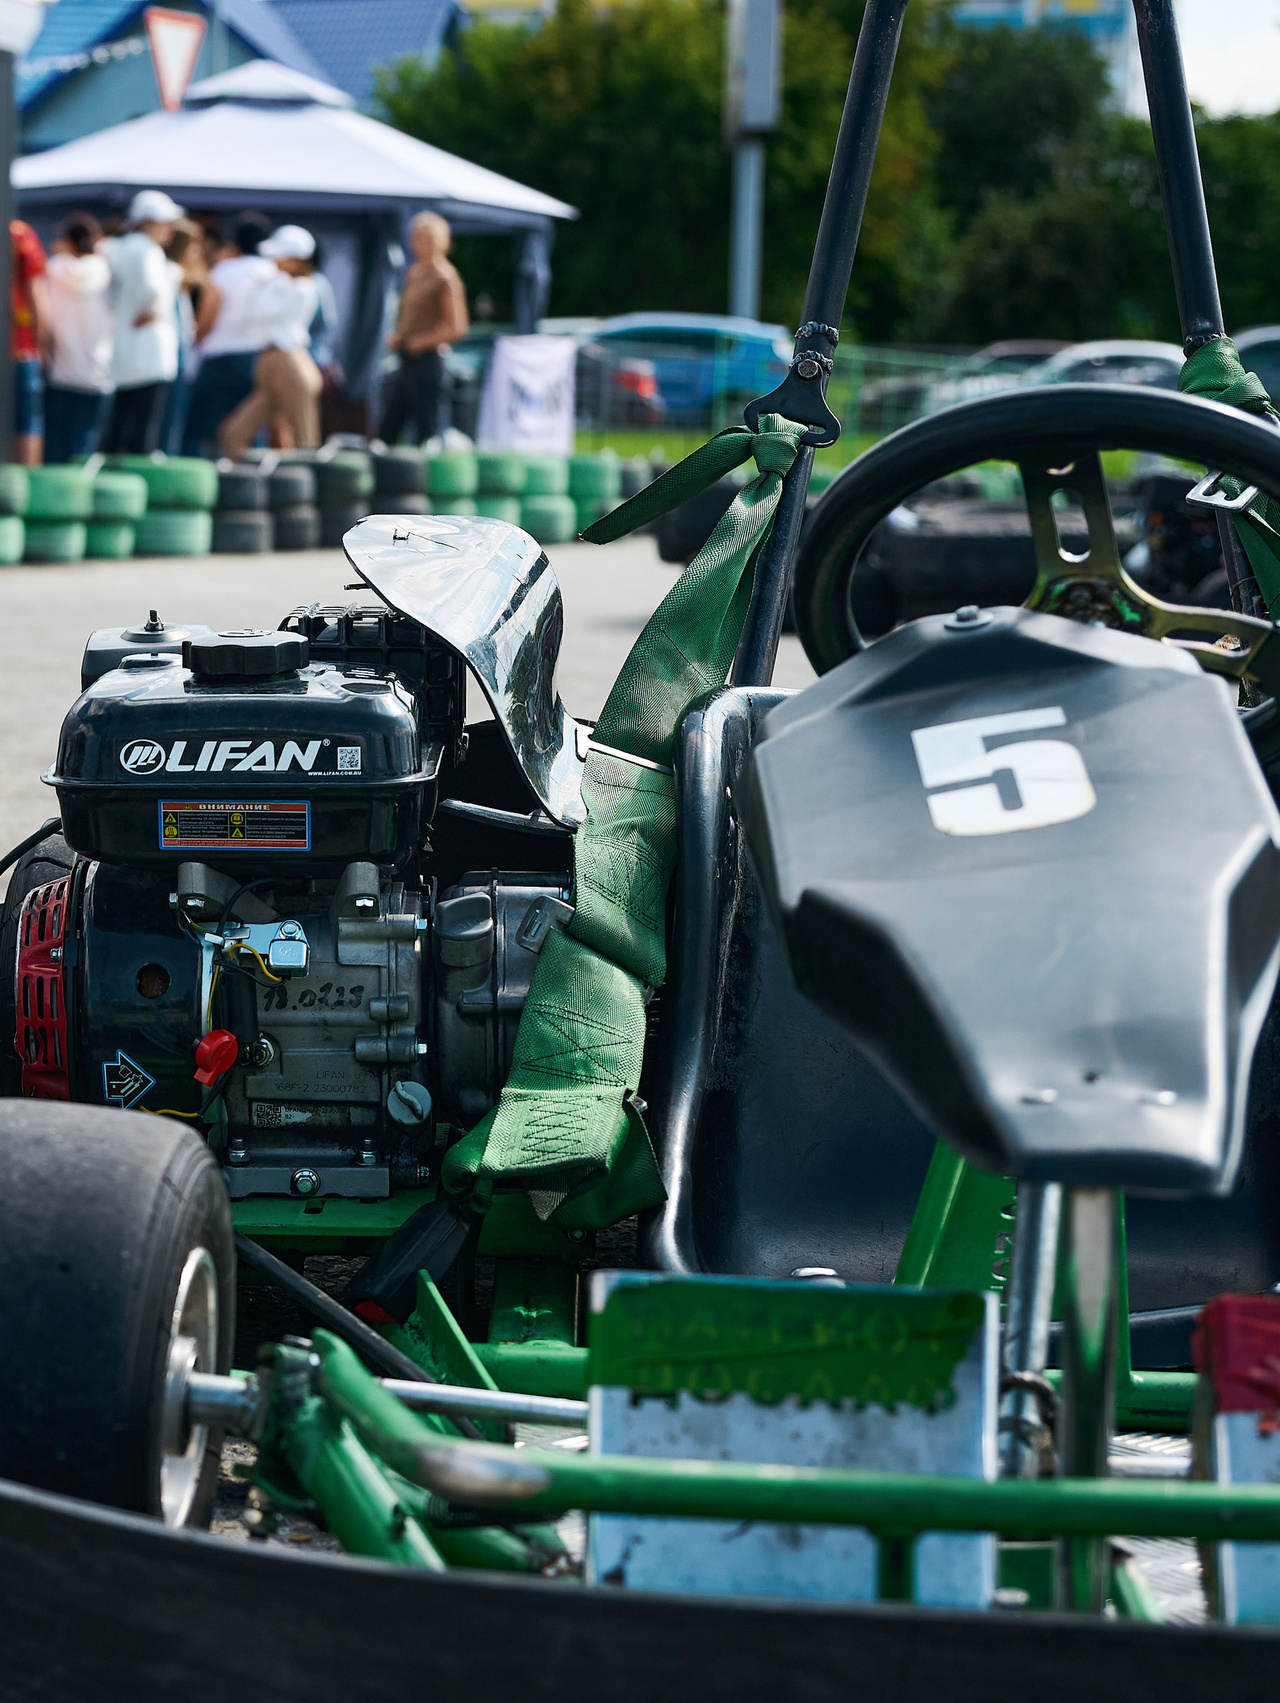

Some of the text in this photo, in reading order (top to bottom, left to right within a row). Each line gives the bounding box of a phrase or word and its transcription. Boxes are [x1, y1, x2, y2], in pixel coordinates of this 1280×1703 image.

[911, 706, 1096, 837] 5
[198, 803, 271, 811] ВНИМАНИЕ
[316, 1070, 345, 1080] LIFAN
[313, 1083, 367, 1094] 23000782
